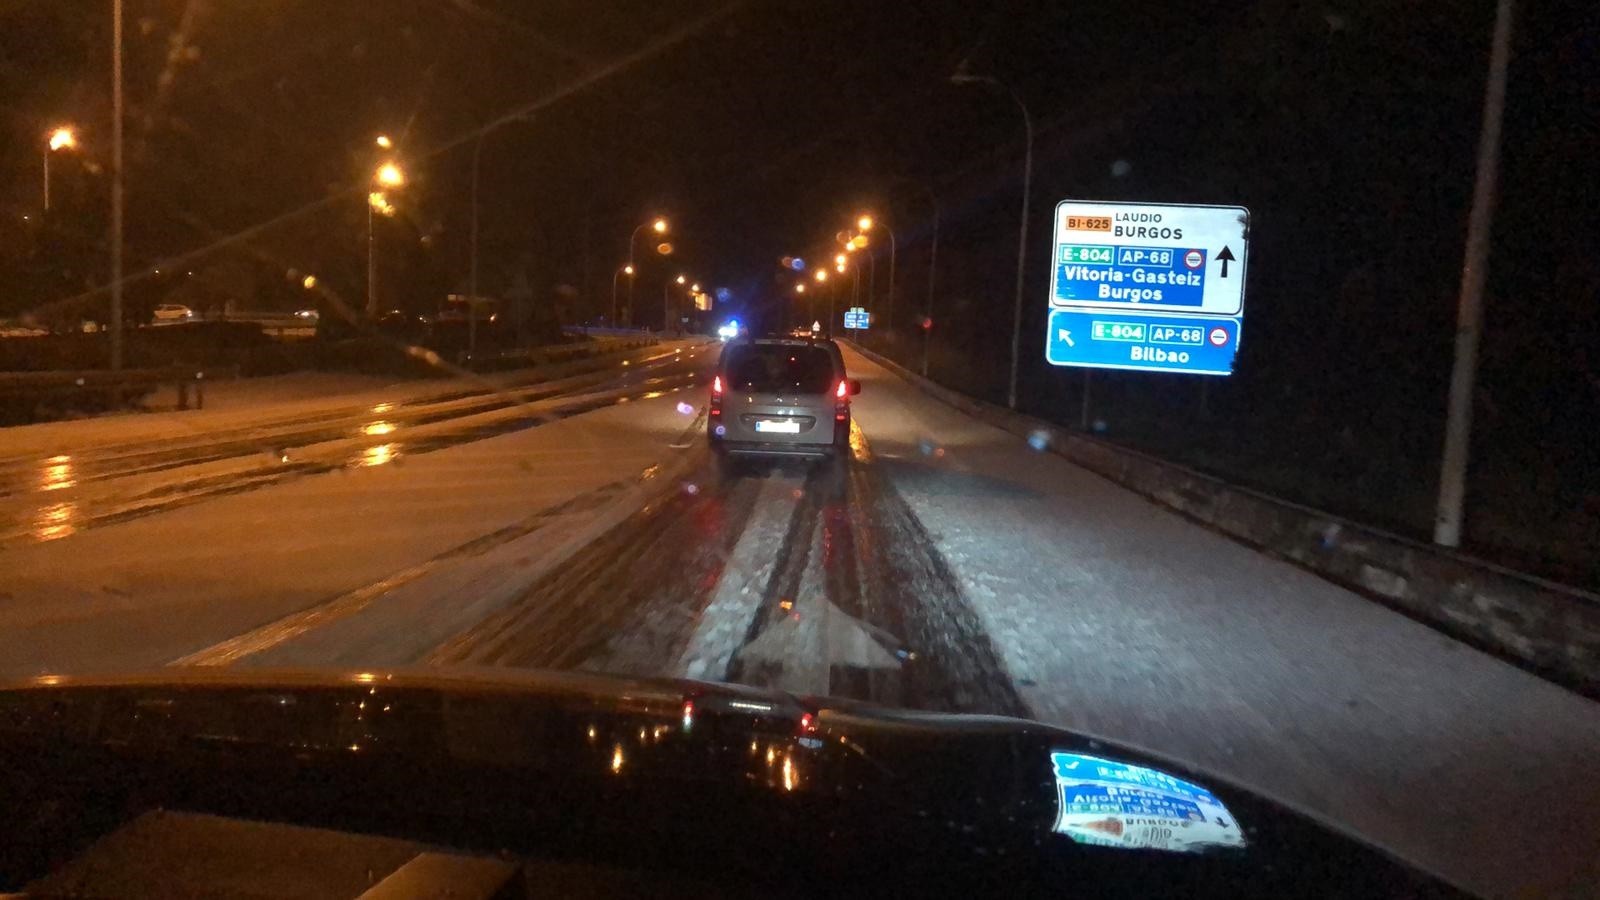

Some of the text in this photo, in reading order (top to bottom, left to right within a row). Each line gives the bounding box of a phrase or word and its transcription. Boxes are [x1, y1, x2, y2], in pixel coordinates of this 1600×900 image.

[1068, 218, 1110, 230] BI-625
[1115, 213, 1162, 223] LAUDIO
[1114, 226, 1183, 240] BURGOS
[1063, 249, 1112, 262] E-804
[1122, 250, 1170, 265] AP-68
[1064, 266, 1201, 286] Vitoria-Gasteiz
[1098, 285, 1163, 303] Burgos
[1095, 324, 1201, 342] E-804 AP-68
[1130, 346, 1190, 363] Bilbao
